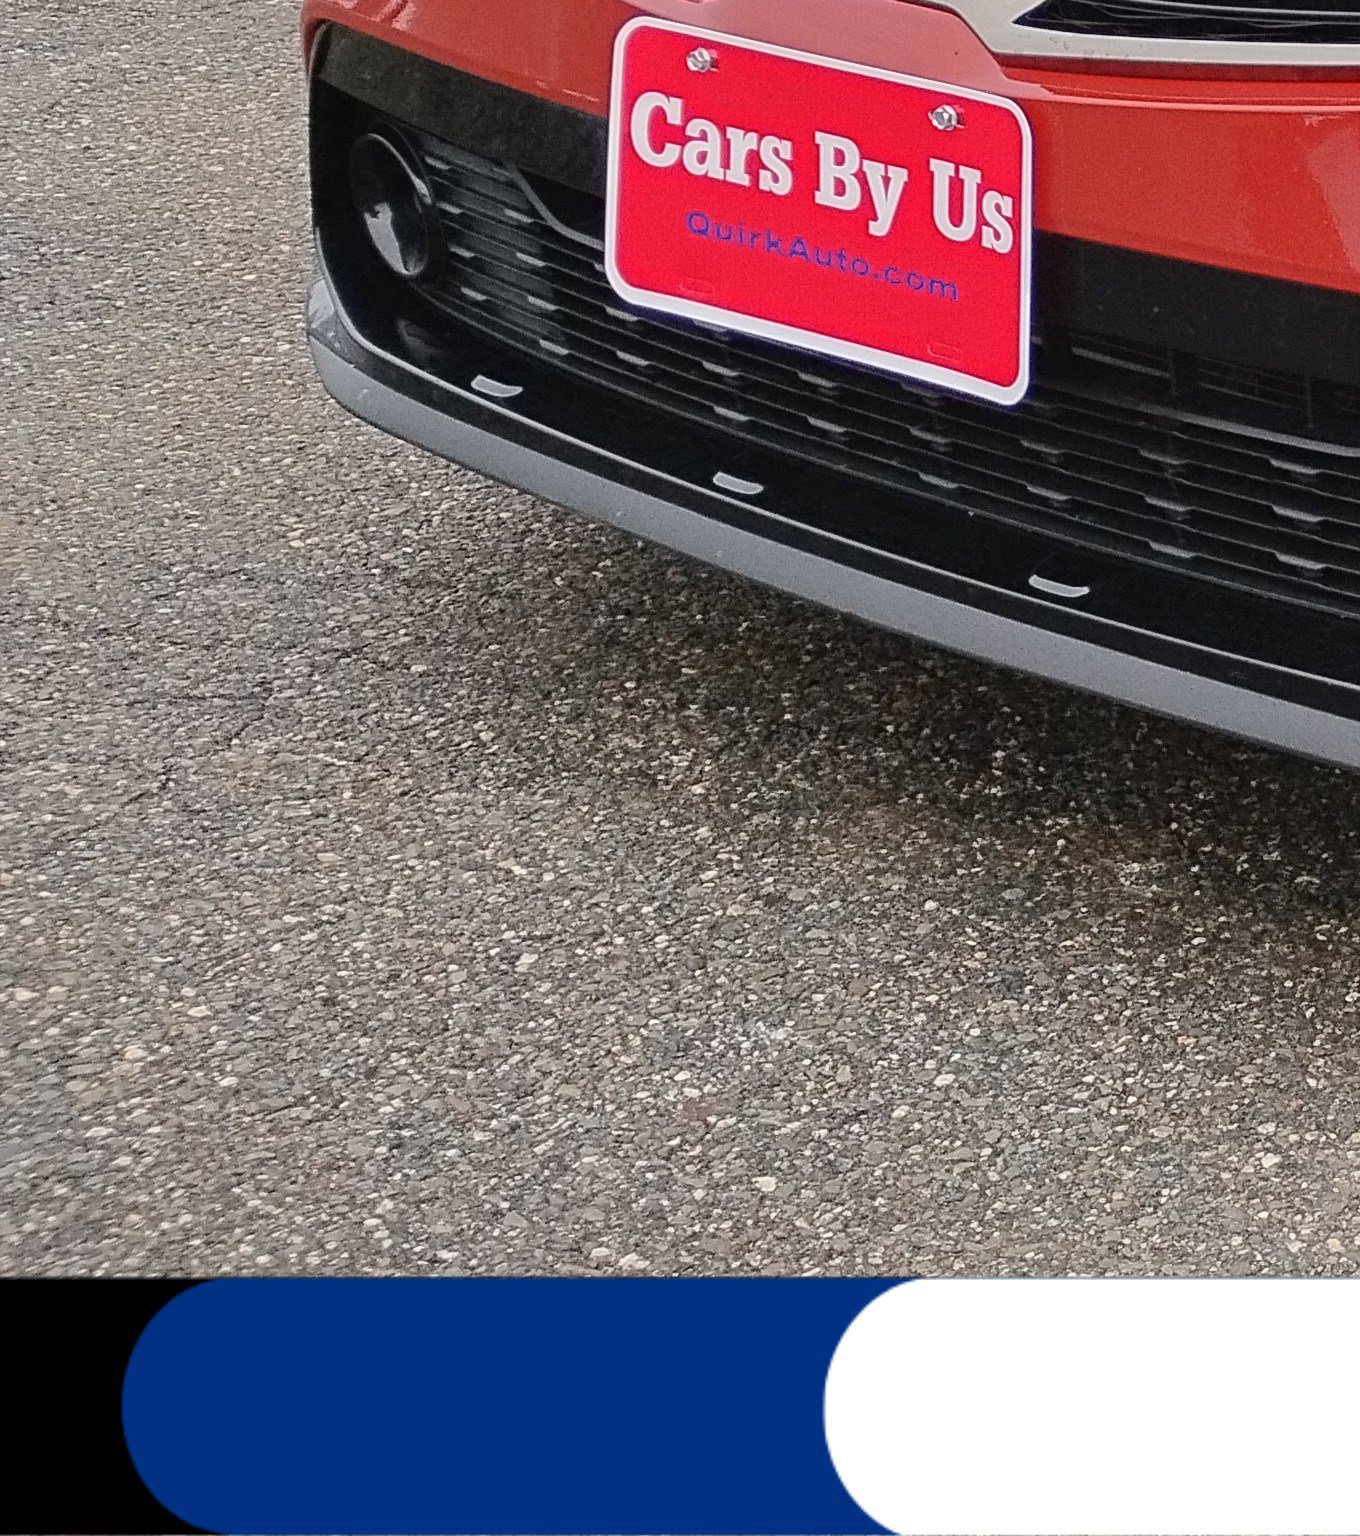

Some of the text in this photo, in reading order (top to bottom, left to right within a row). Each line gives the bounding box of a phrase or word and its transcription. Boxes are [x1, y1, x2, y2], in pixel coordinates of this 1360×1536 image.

[631, 91, 1015, 254] Cars By Us
[685, 210, 959, 302] QuirkAuto.com
